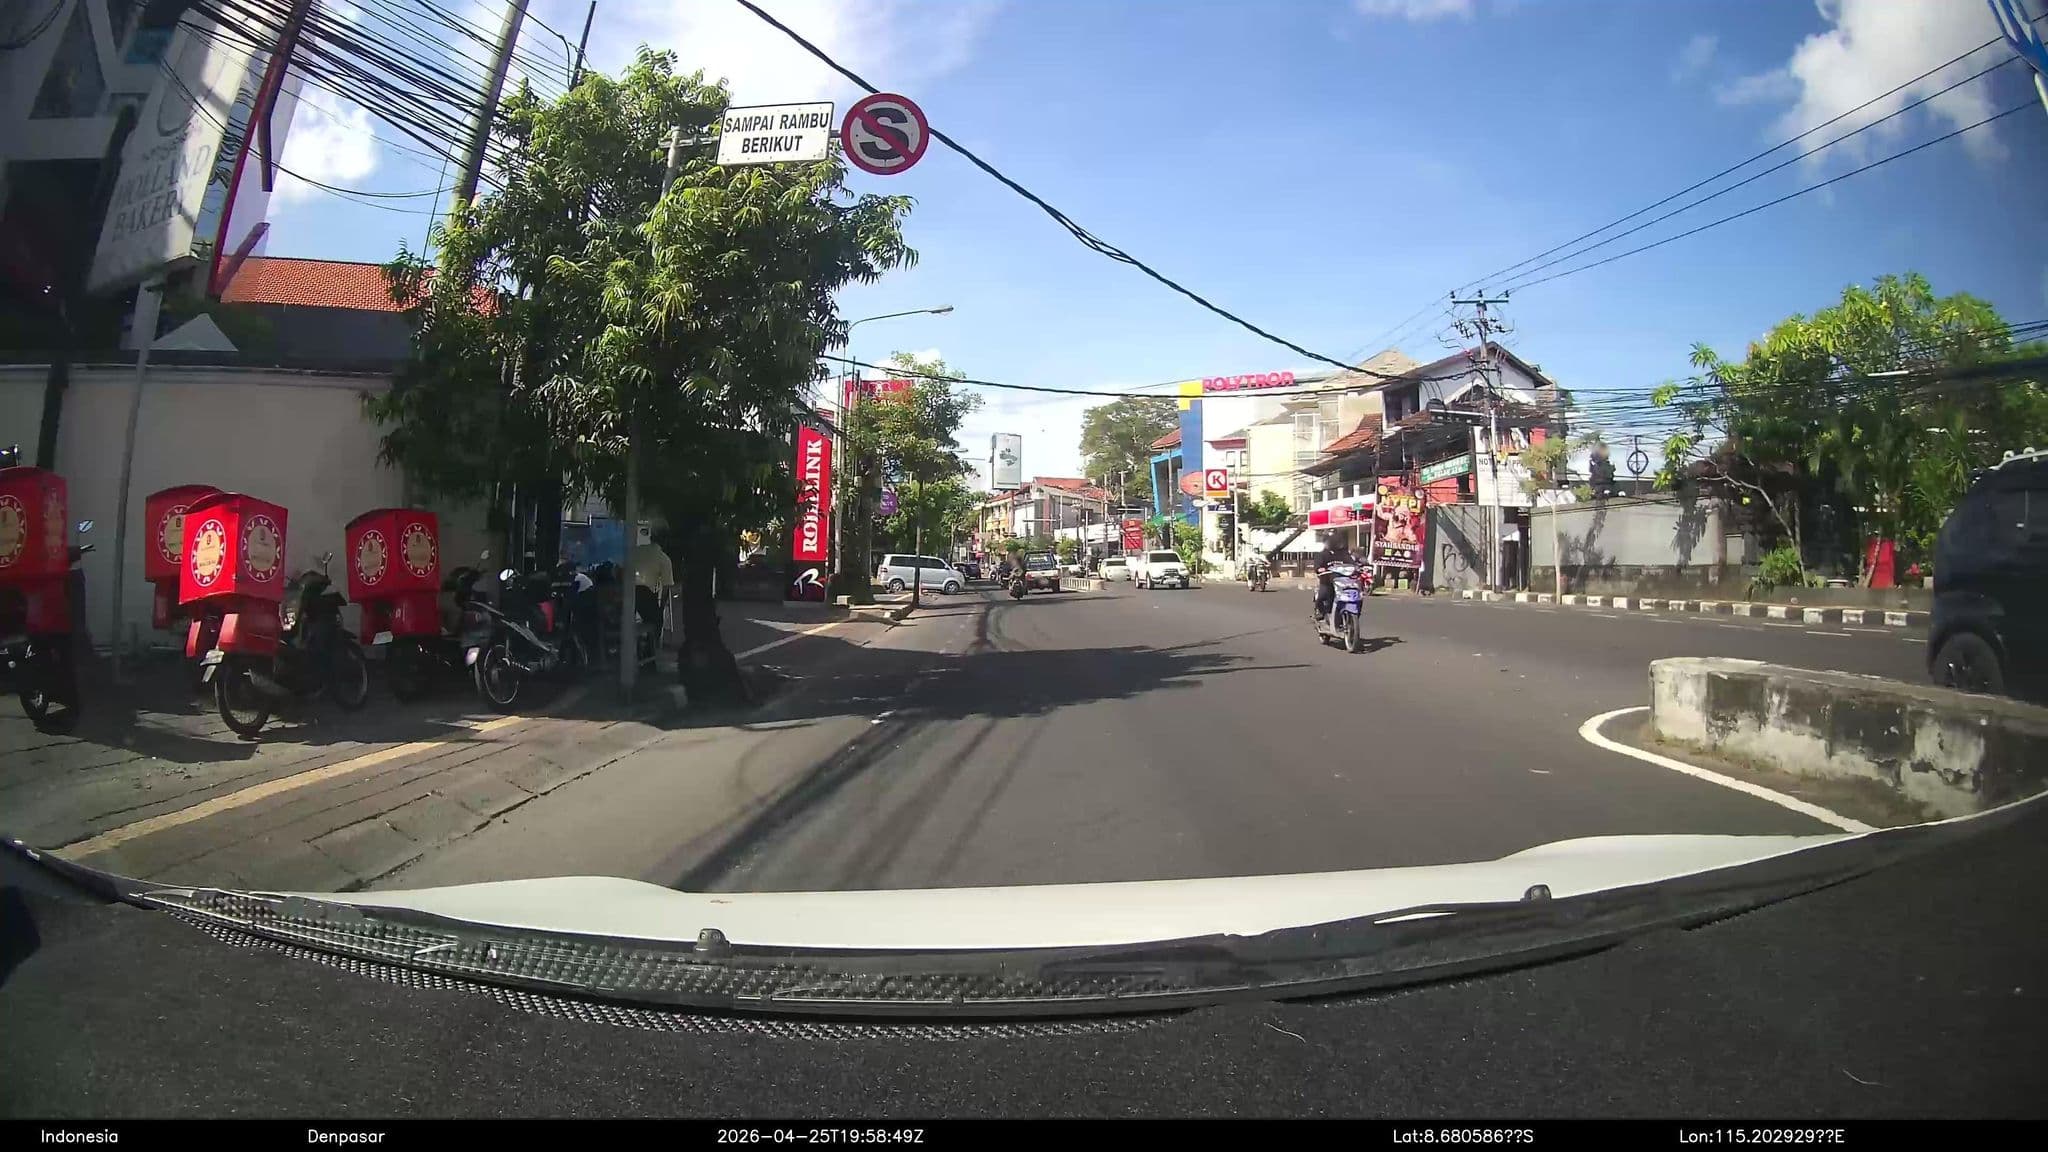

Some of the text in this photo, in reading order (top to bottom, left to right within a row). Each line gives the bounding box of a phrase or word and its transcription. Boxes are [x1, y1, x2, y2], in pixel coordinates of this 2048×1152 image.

[724, 112, 830, 133] SAMPAI RAMBU
[741, 135, 803, 154] BERIKUT
